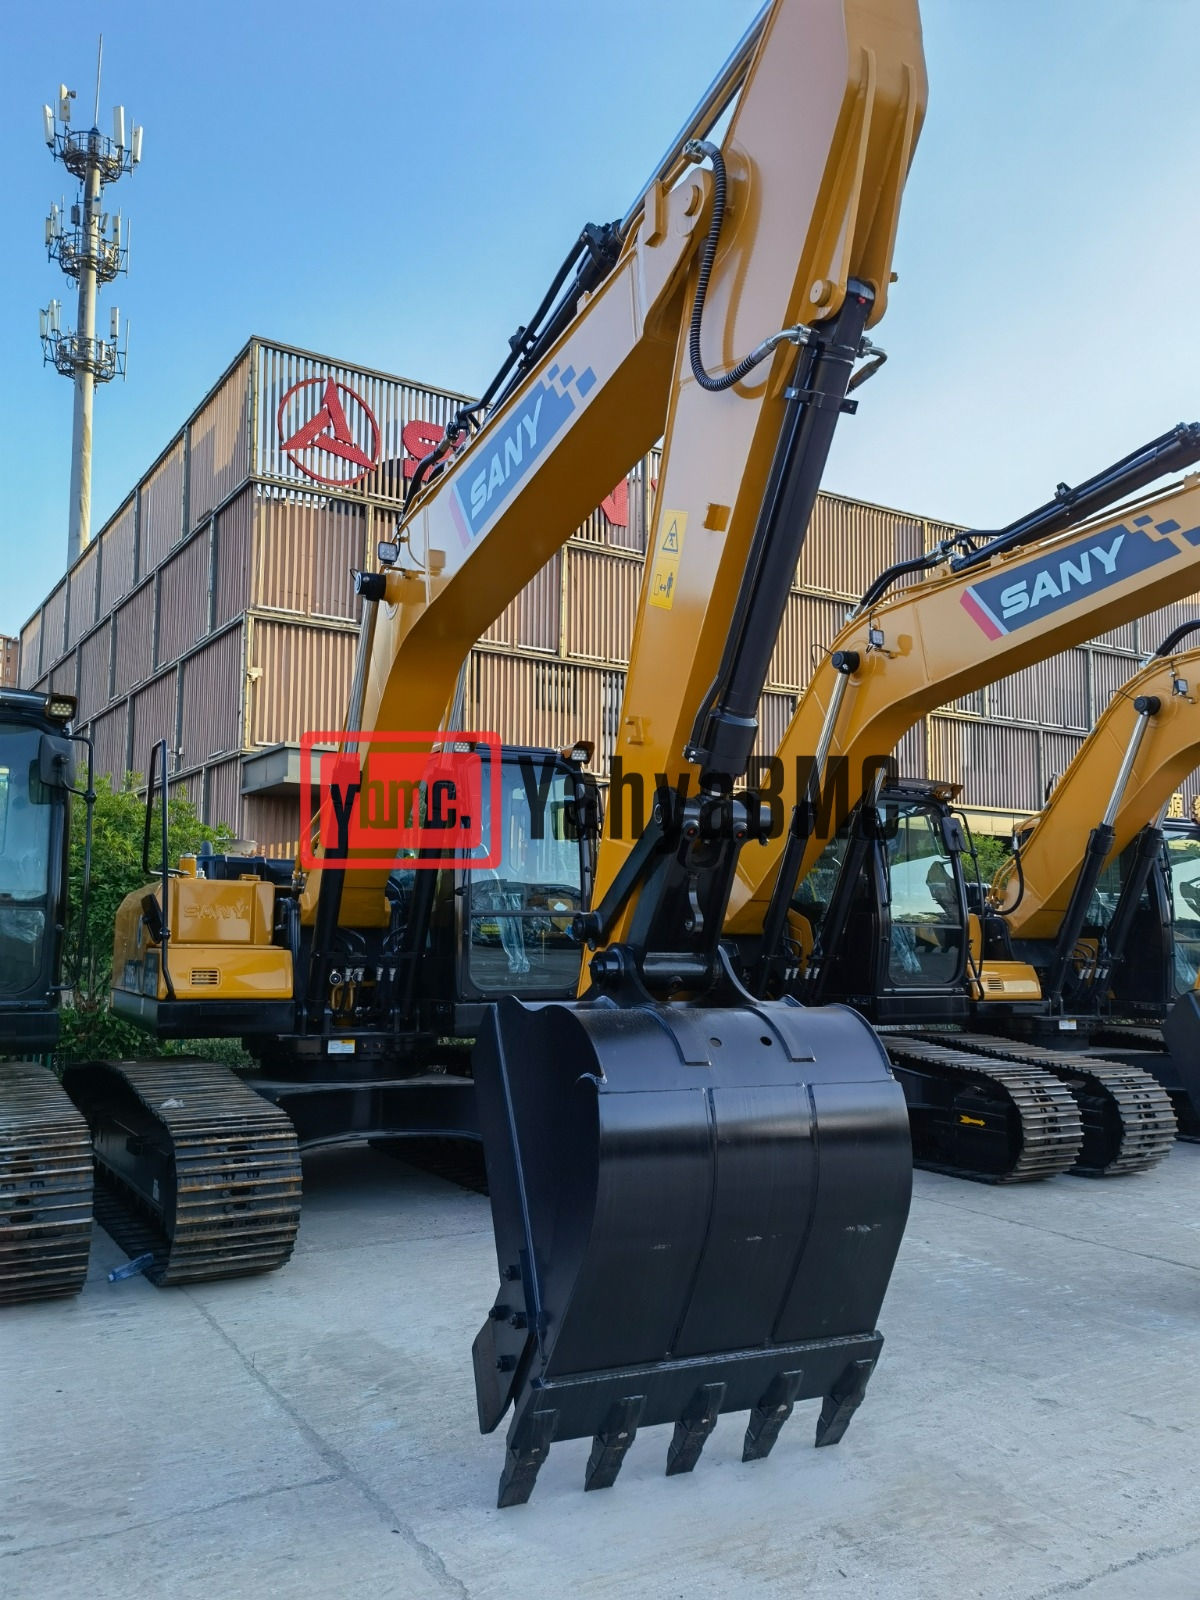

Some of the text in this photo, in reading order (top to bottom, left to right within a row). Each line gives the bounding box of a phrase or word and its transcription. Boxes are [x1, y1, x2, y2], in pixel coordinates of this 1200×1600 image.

[470, 394, 543, 519] SANY
[1000, 534, 1125, 619] SANY
[183, 899, 249, 920] SANY
